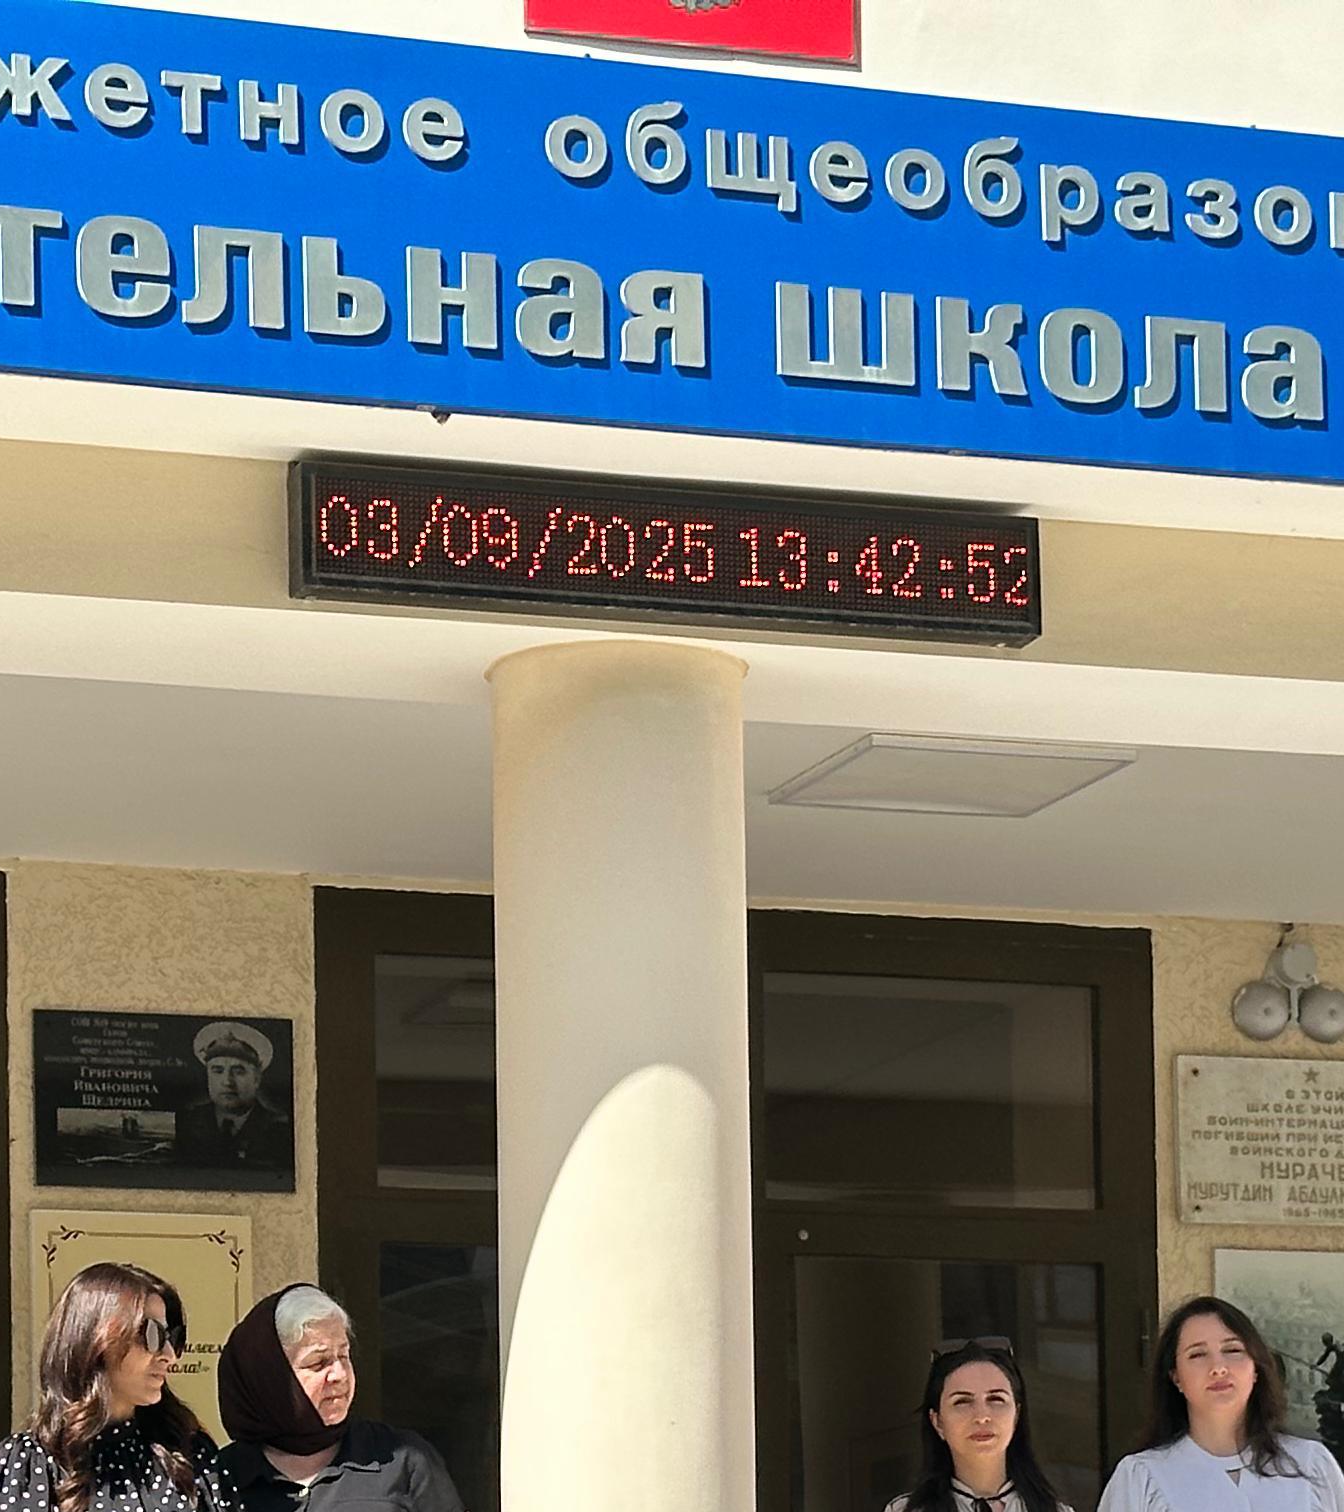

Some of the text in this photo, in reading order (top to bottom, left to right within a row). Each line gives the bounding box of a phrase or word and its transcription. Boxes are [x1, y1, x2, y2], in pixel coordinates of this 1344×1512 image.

[775, 281, 1325, 421] школа
[319, 494, 1028, 606] 03/09/2025 13:42:52
[1246, 1103, 1306, 1114] ШКОЛЕ
[1286, 1133, 1318, 1144] ПРИ
[1229, 1146, 1329, 1158] ВОИНСКОГО
[1187, 1181, 1273, 1201] НУРУТДИН
